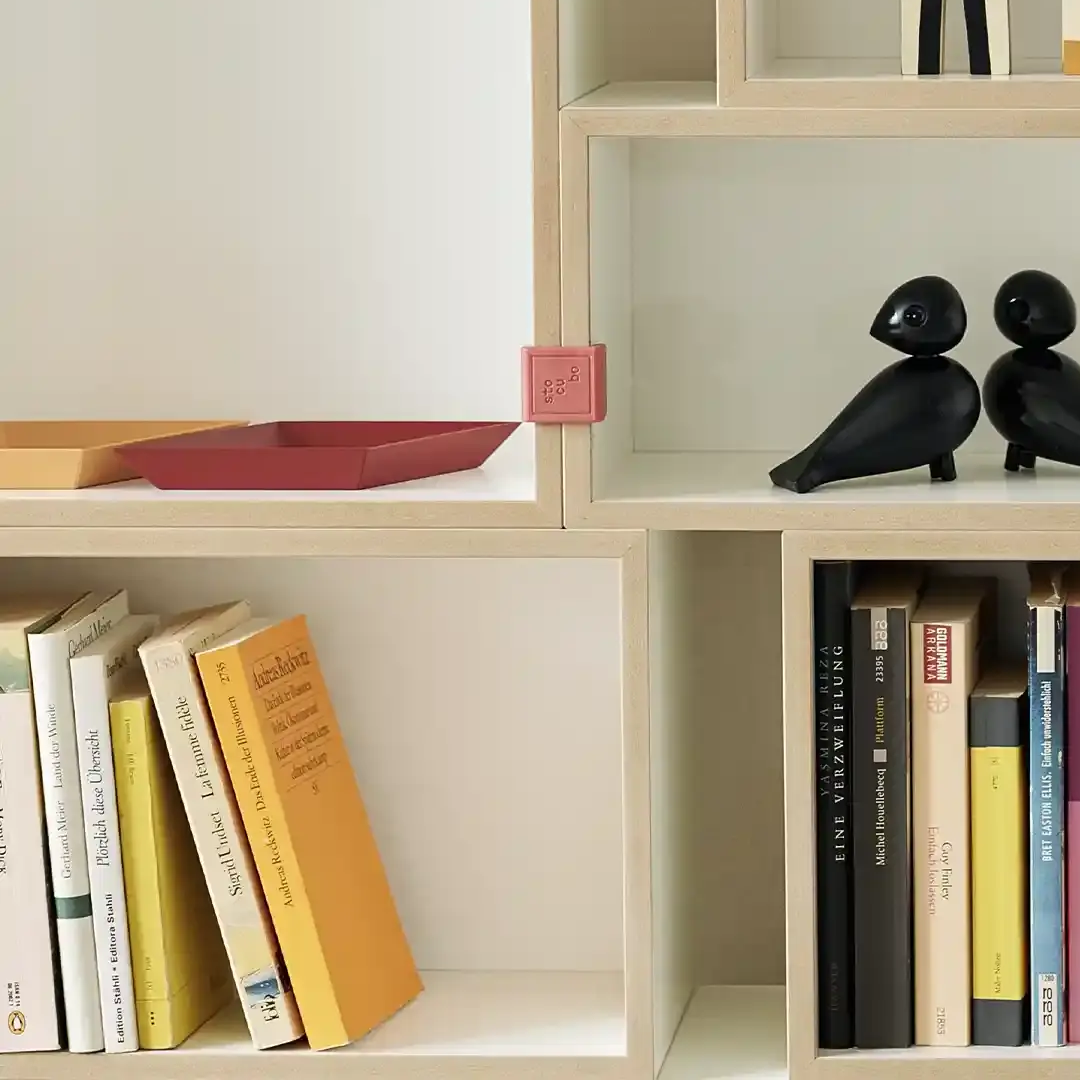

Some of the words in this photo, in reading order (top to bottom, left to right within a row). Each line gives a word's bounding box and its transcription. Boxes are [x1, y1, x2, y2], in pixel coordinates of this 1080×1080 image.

[542, 380, 554, 404] sto
[556, 379, 566, 395] cu
[568, 366, 580, 382] bo
[818, 646, 829, 693] REZA
[876, 656, 884, 683] 23395
[926, 628, 936, 680] ARKANA
[937, 628, 948, 680] GOLDMANN
[216, 662, 231, 685] 2735
[46, 703, 59, 738] Winde
[176, 696, 195, 731] fidèle
[227, 696, 248, 746] Illusionen
[833, 645, 844, 803] VERZWEIFLUNG
[875, 697, 885, 744] Plattform
[1040, 680, 1052, 739] unwiderstehlich!
[49, 741, 60, 758] der
[85, 730, 103, 784] Übersicht
[186, 733, 208, 778] femme
[240, 747, 253, 763] der
[819, 708, 830, 797] YASMINA
[1040, 741, 1052, 767] Einfach
[50, 761, 63, 788] Land
[201, 780, 214, 799] La
[244, 764, 260, 790] Ende
[1041, 771, 1052, 798] ELLIS.
[56, 801, 68, 831] Meier
[92, 788, 105, 815] diese
[254, 790, 267, 811] Das
[875, 769, 887, 830] Houellebecq
[209, 811, 232, 858] Undset
[1041, 802, 1052, 836] EASTON
[93, 820, 109, 866] Plötzlich
[262, 816, 284, 865] Reckwitz
[835, 816, 845, 861] EINE
[876, 832, 886, 866] Michel
[928, 826, 939, 866] Einfach
[940, 842, 952, 865] Guy
[1041, 840, 1053, 861] BRET
[58, 835, 72, 879] Gerhard
[221, 859, 243, 897] Sigrid
[275, 866, 294, 907] Andreas
[928, 870, 939, 915] loslassen
[940, 868, 952, 900] Finley
[109, 926, 118, 963] Editora
[115, 1006, 125, 1043] Edition
